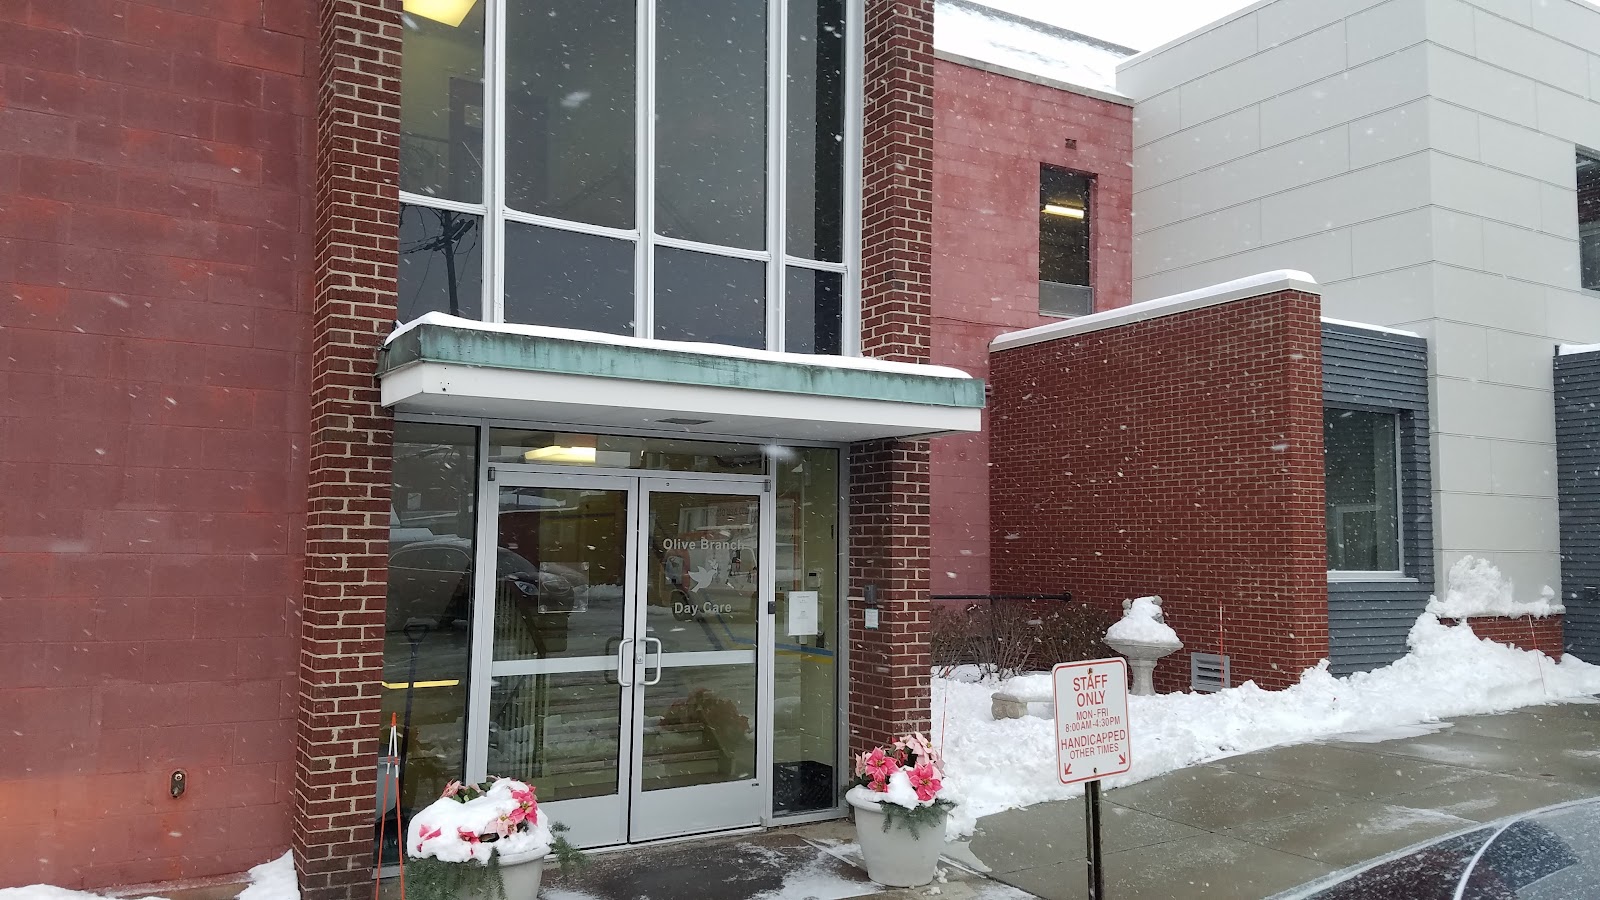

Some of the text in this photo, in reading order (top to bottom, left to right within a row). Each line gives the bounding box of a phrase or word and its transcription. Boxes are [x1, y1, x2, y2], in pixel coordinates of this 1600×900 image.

[663, 538, 744, 550] Olive Branch
[674, 602, 732, 616] Day Care
[1073, 674, 1107, 691] STAFF
[1076, 690, 1106, 707] ONLY
[1061, 729, 1126, 750] HANDICAPPED
[1069, 743, 1119, 759] OTHER TIMES
